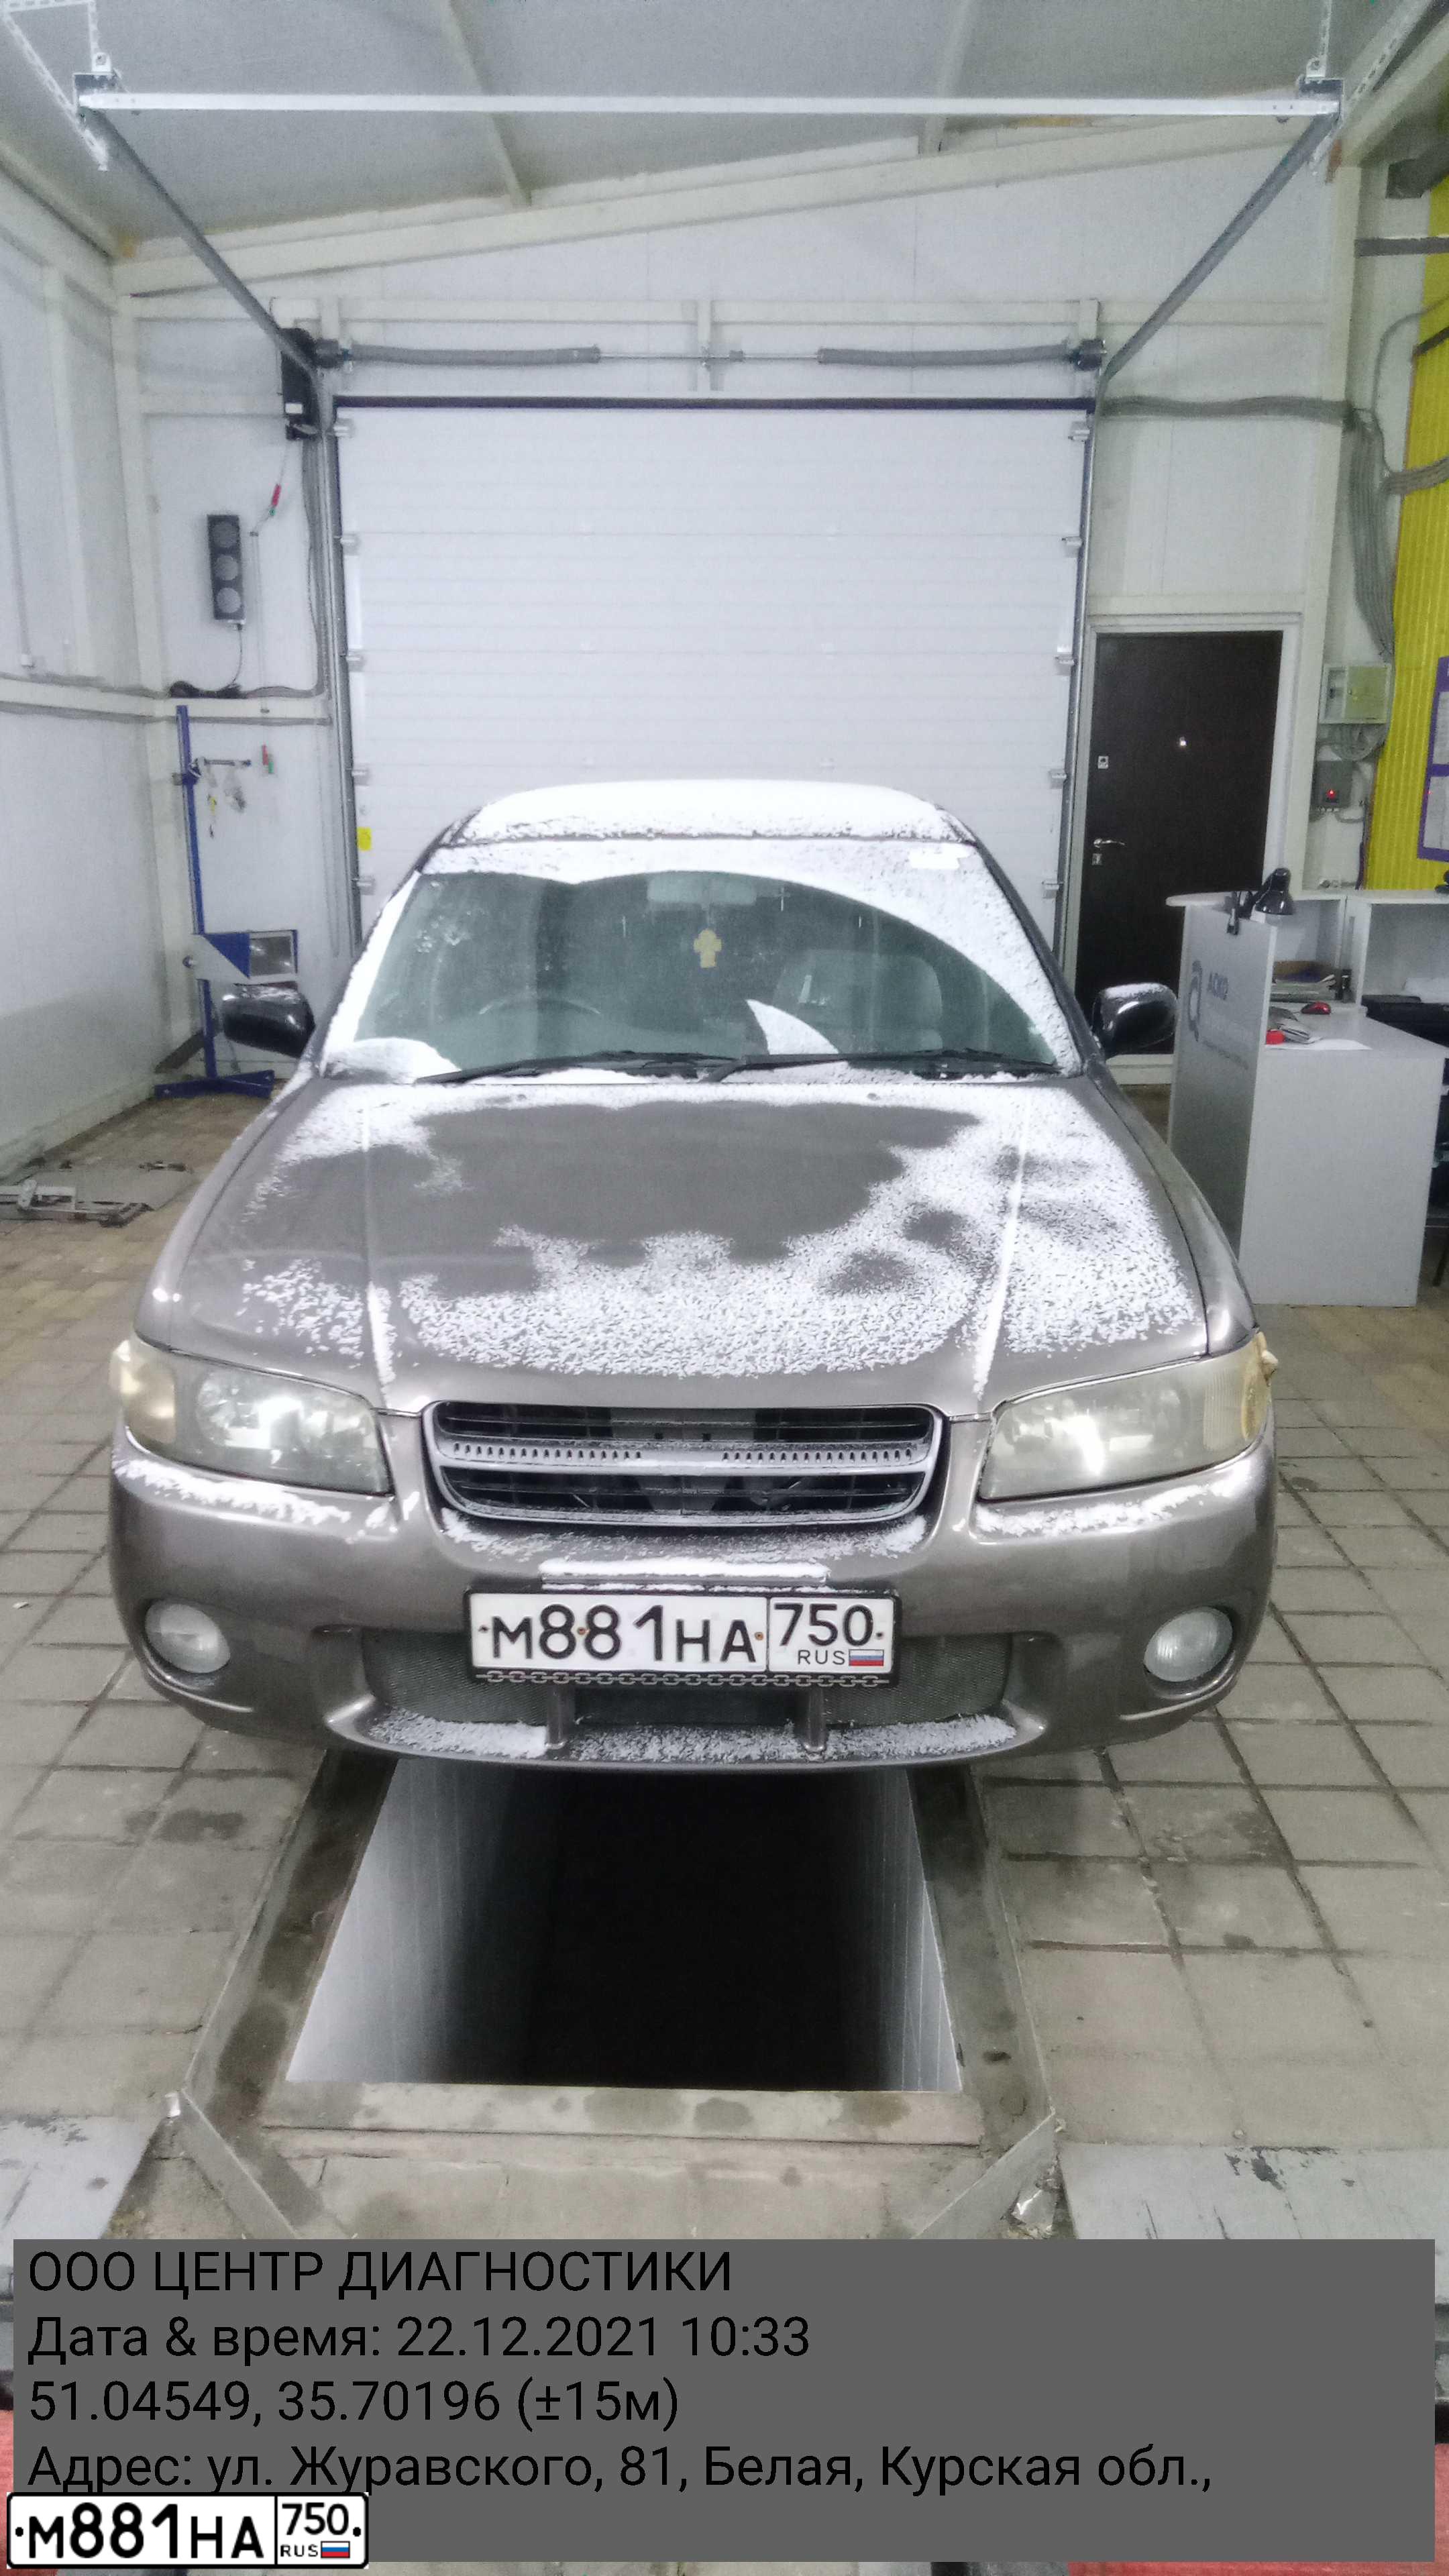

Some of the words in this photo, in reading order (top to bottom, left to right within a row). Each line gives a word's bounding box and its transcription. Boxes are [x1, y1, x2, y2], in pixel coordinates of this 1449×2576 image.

[492, 1604, 756, 1662] М881НА
[774, 1603, 873, 1647] 750
[798, 1650, 845, 1665] RUS
